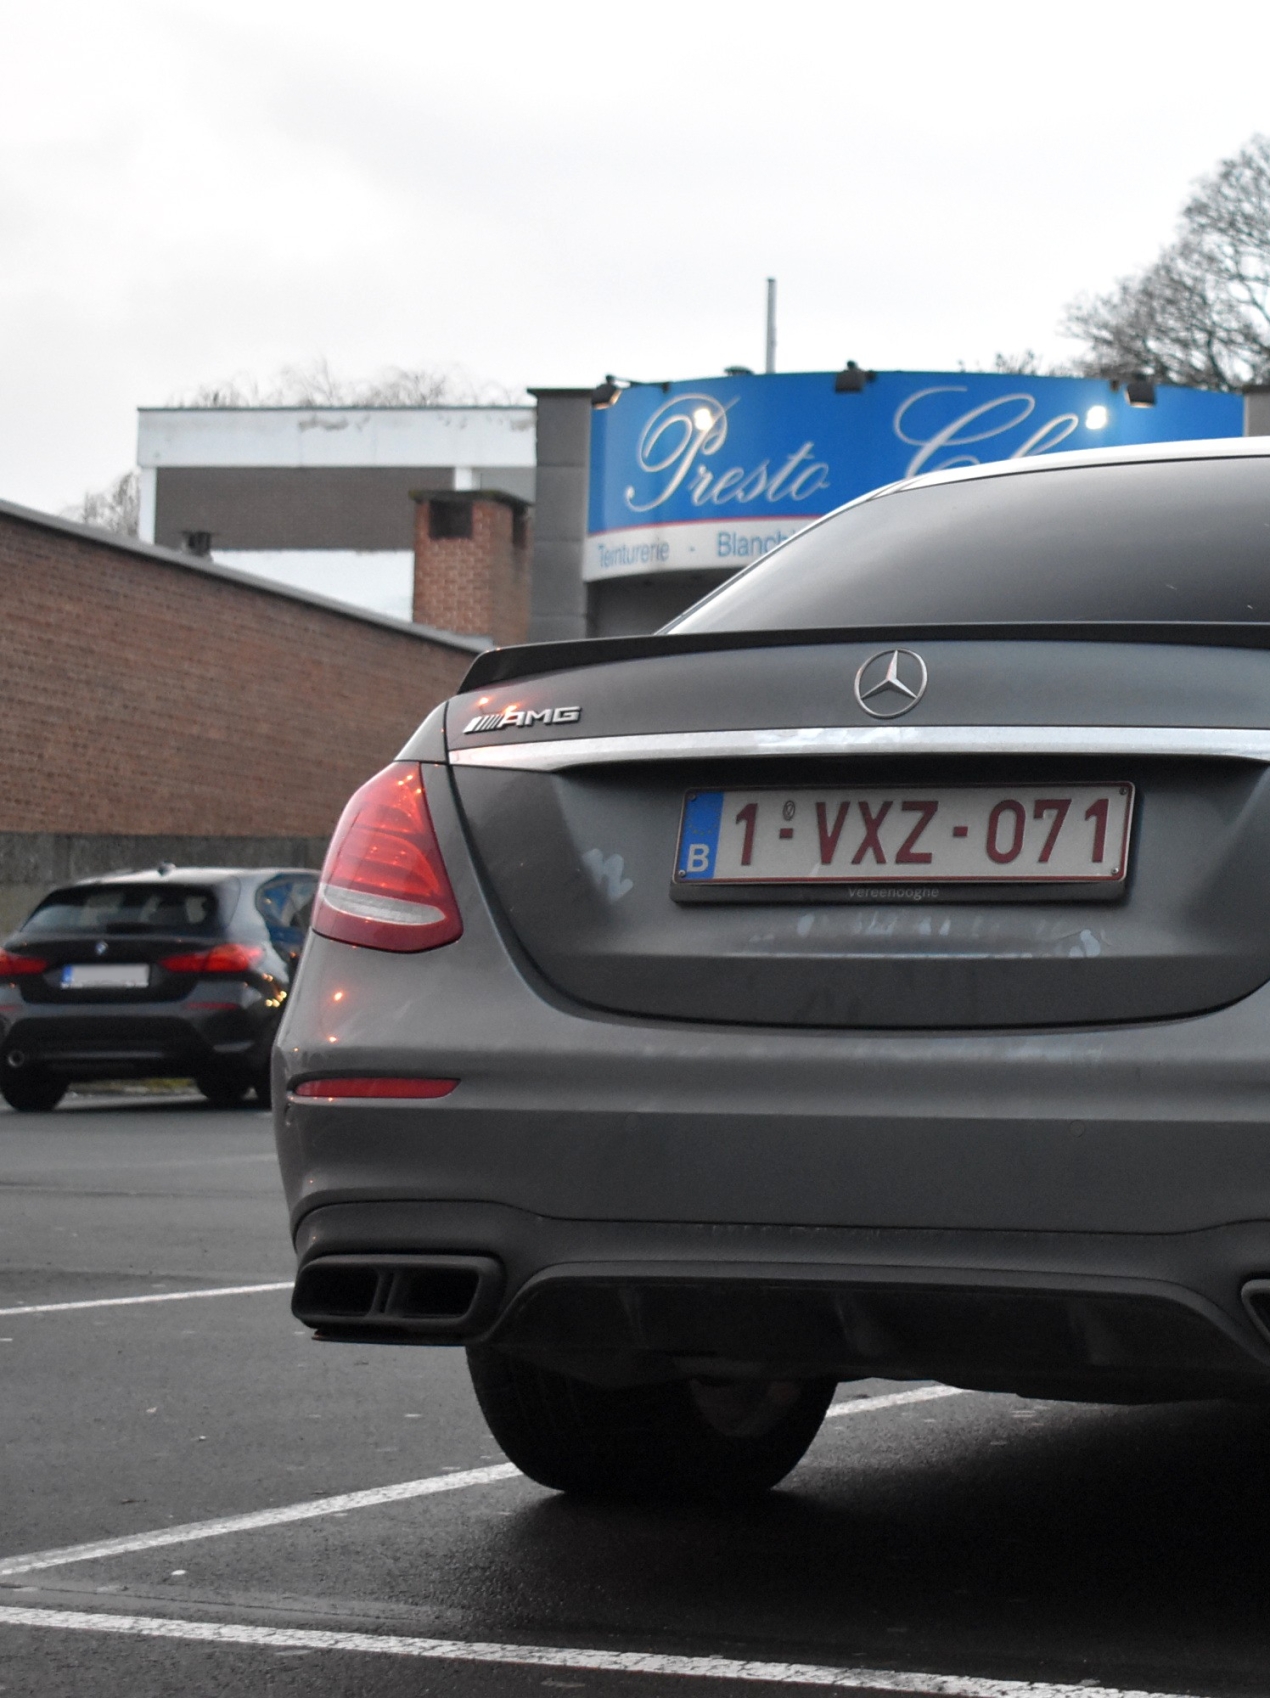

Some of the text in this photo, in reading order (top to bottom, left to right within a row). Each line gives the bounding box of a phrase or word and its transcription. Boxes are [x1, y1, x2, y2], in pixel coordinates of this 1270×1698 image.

[626, 392, 831, 512] Presto
[597, 540, 670, 569] Teinturerie
[717, 530, 797, 558] Blanch
[497, 706, 581, 728] AMG
[686, 843, 710, 873] B
